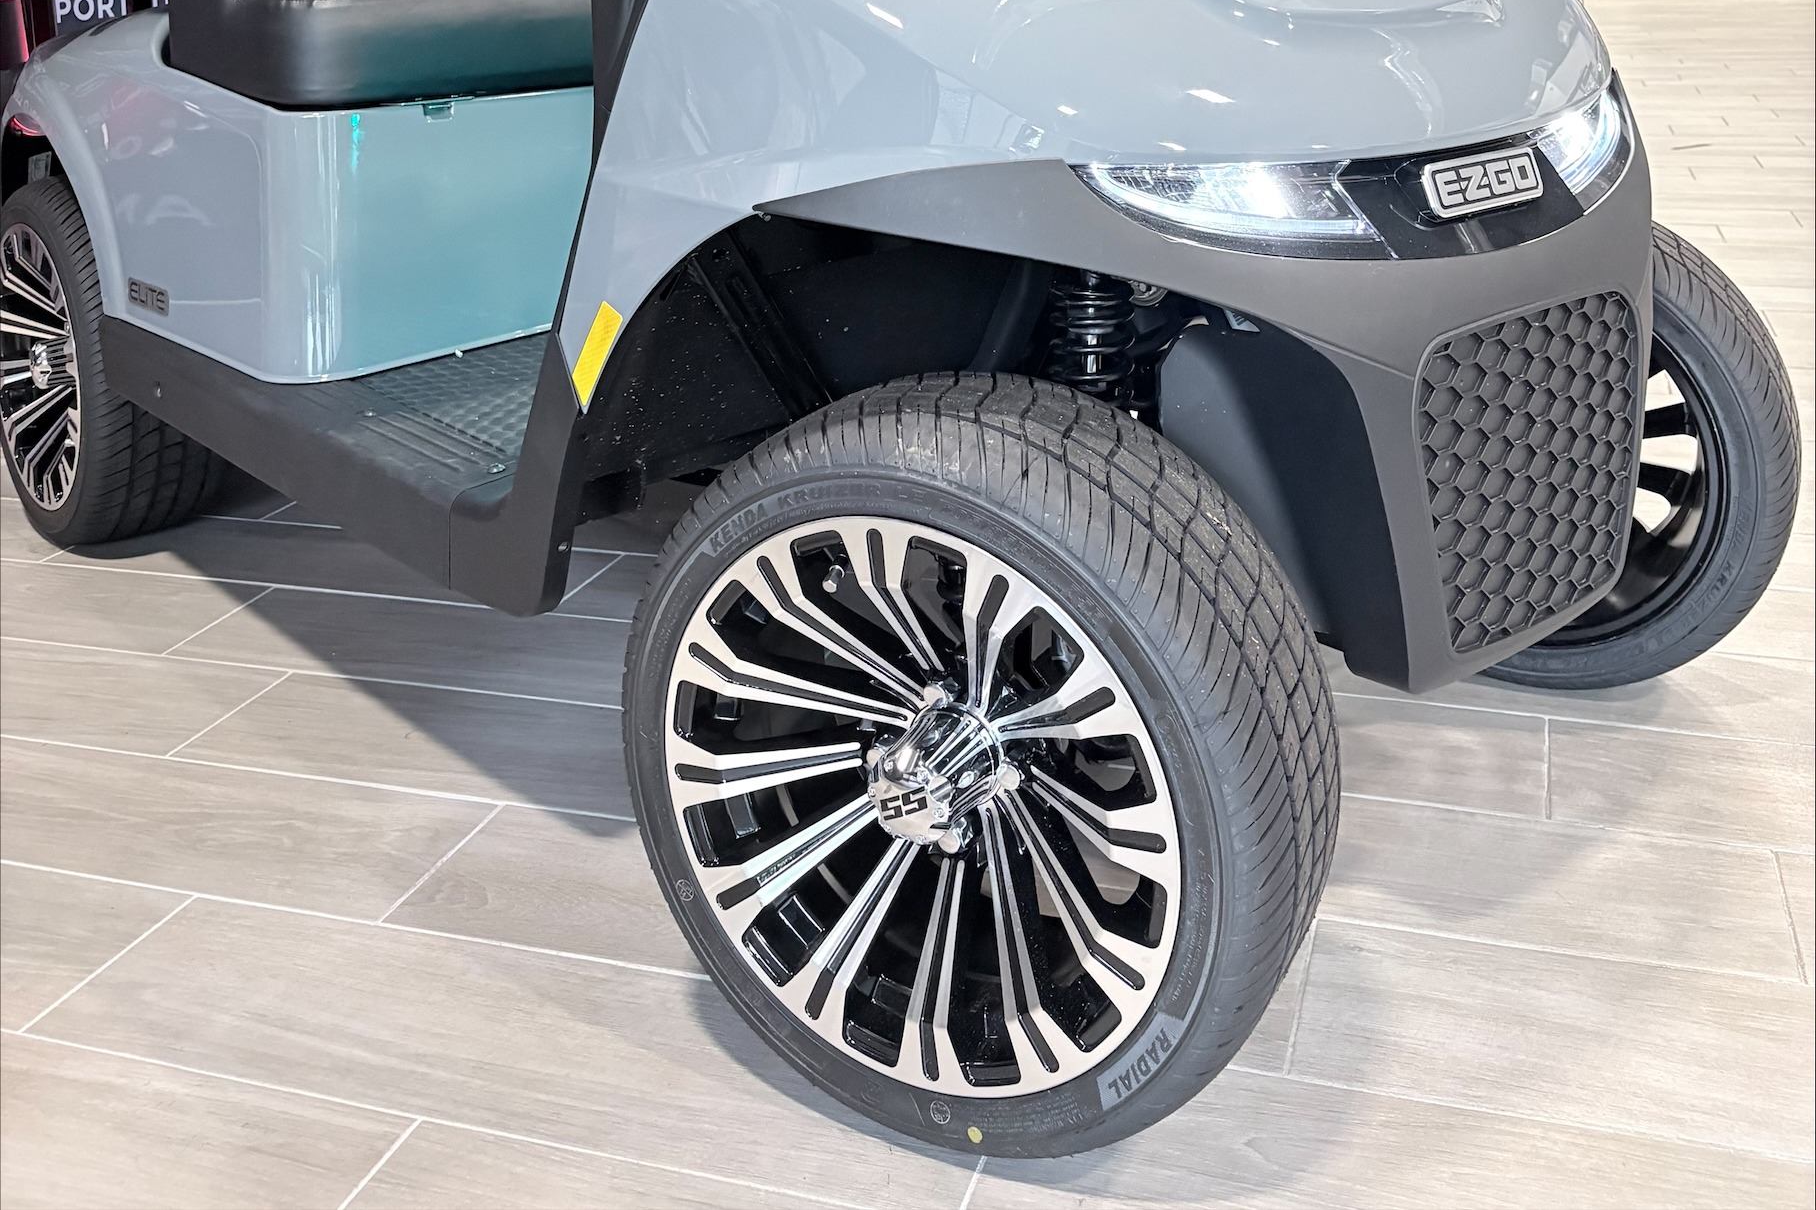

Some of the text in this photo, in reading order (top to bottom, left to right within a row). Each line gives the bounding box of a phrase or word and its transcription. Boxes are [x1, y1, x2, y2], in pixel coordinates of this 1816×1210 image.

[129, 281, 166, 311] ELITE
[708, 503, 769, 553] KENDA
[880, 786, 928, 821] SS
[1107, 1028, 1175, 1099] RADIAL
